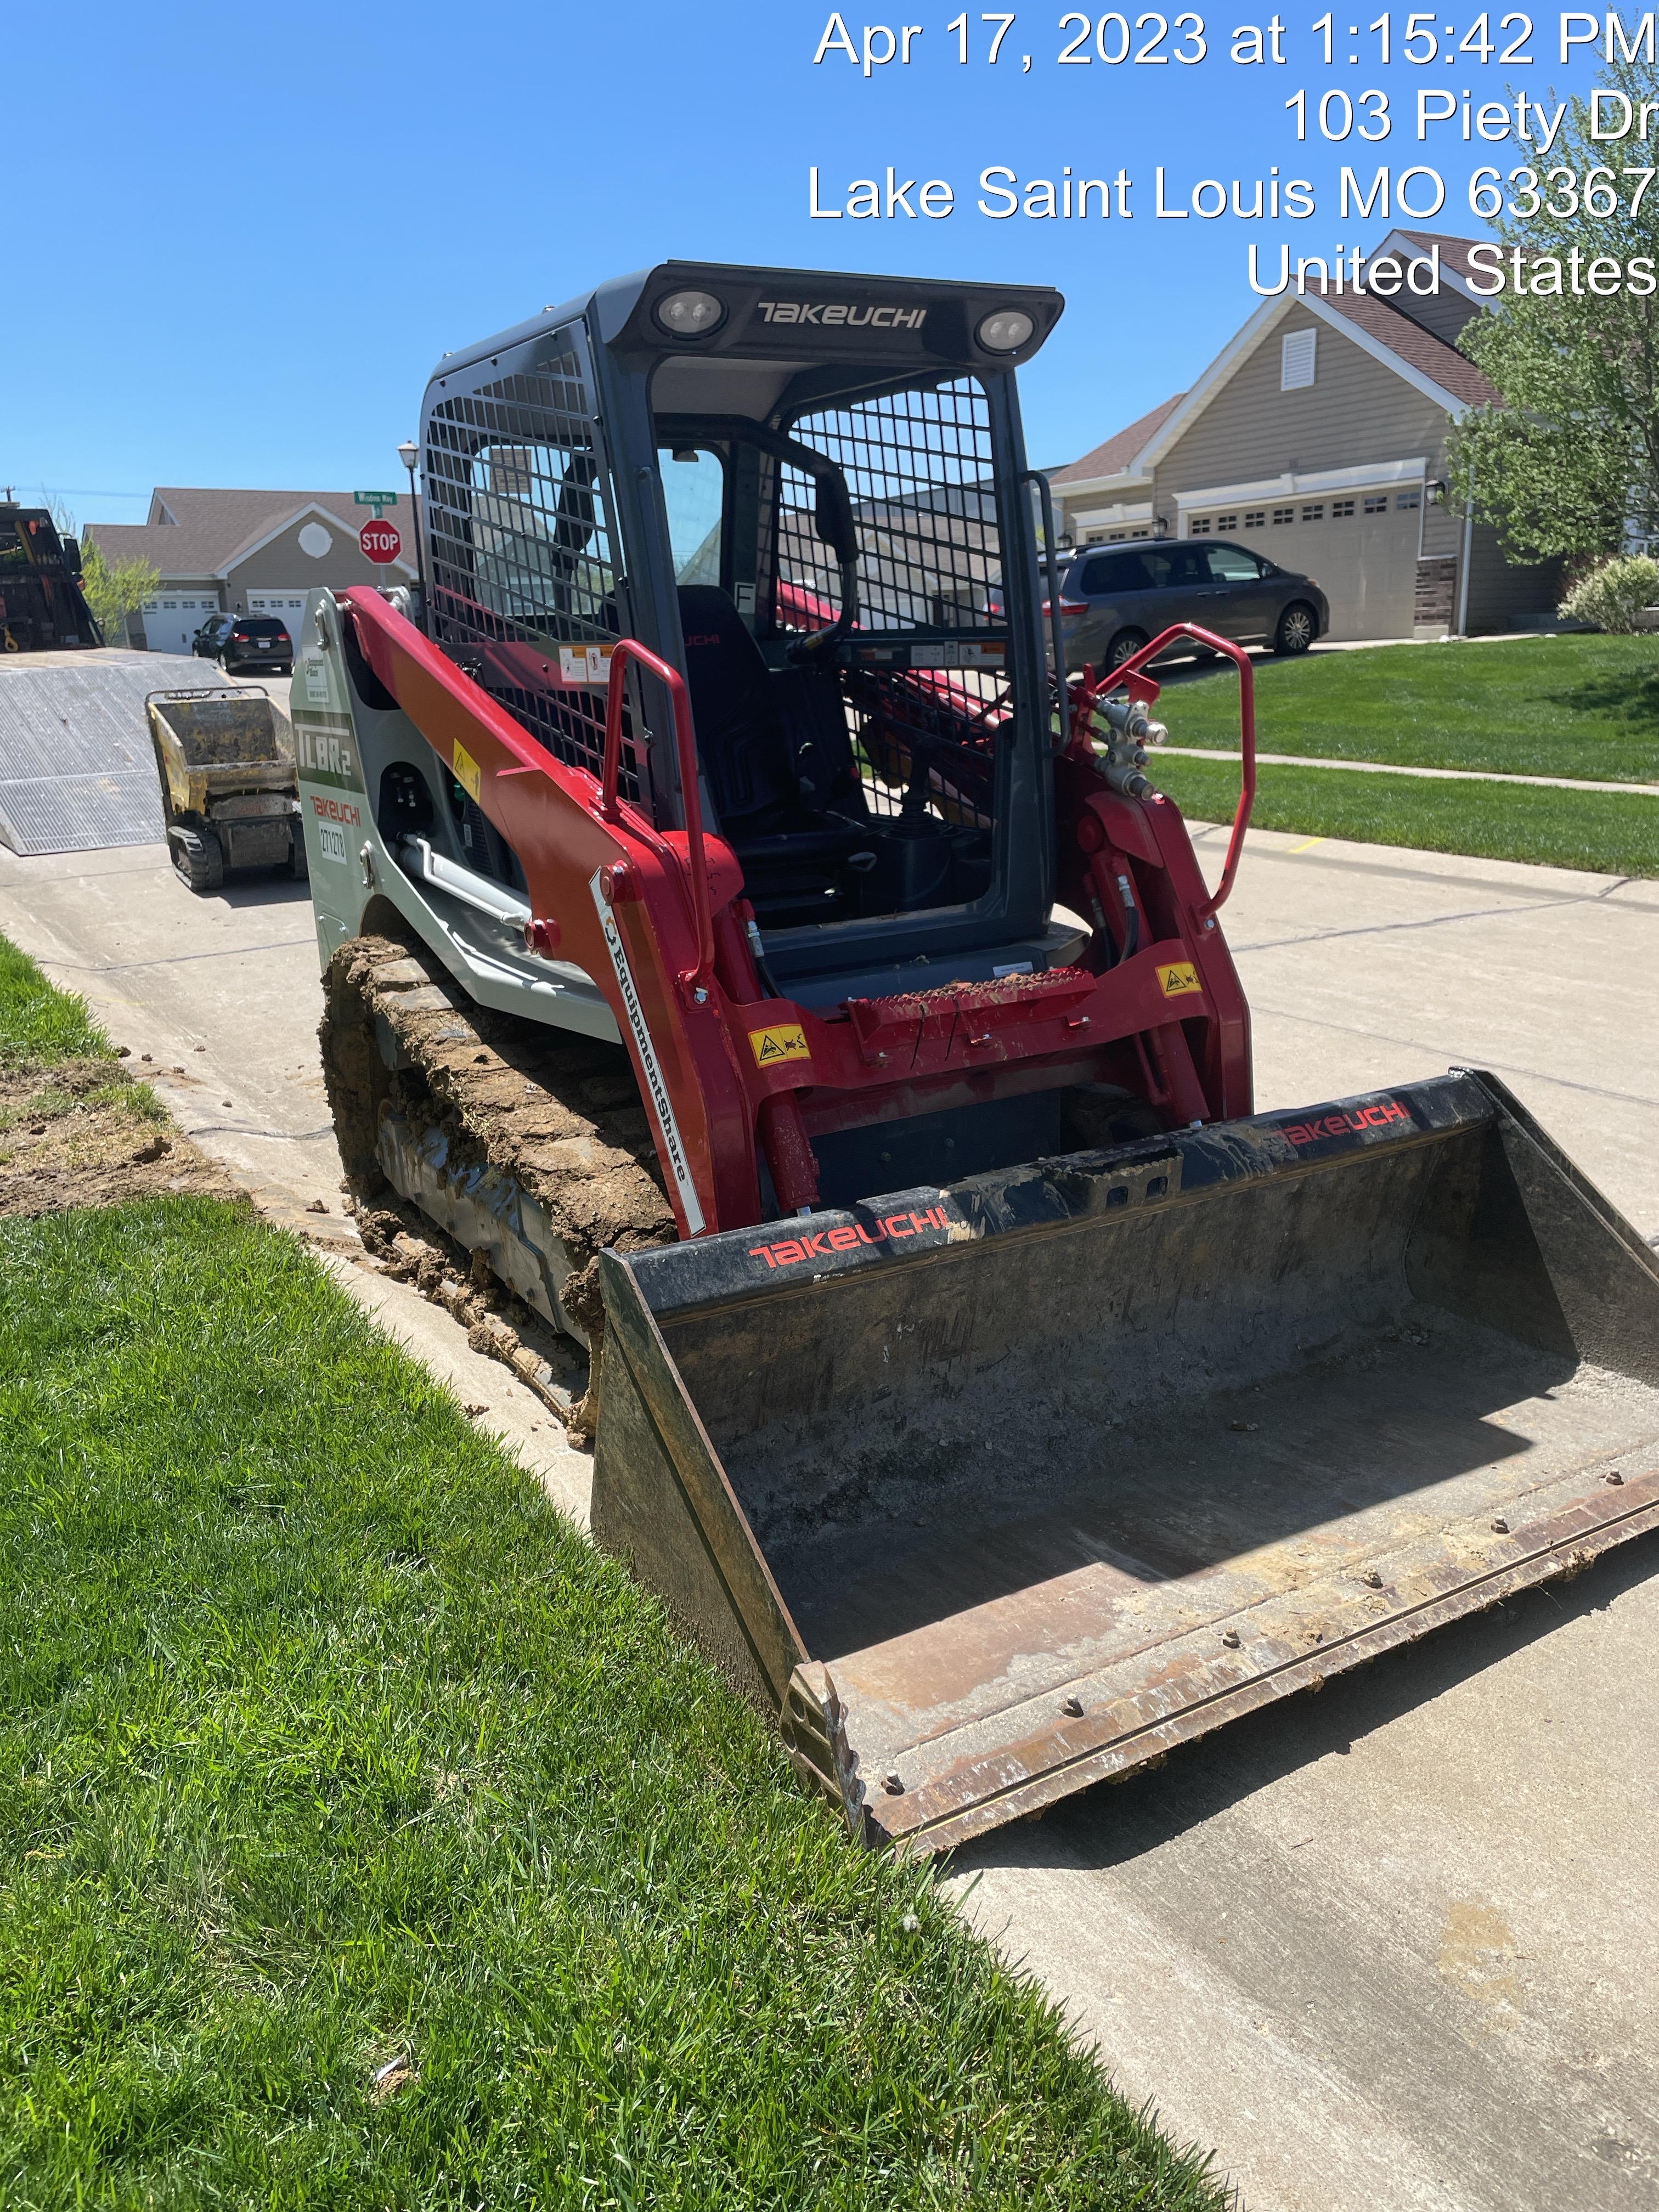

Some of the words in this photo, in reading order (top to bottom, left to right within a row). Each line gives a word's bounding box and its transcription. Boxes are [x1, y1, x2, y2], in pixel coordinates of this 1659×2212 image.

[757, 301, 927, 329] TAKEUCHI
[362, 533, 398, 551] STOP
[310, 795, 361, 828] TAKEUCHI
[320, 828, 345, 857] 271278
[613, 945, 685, 1182] EquipmentShare
[749, 1205, 948, 1268] TAKEUCHI
